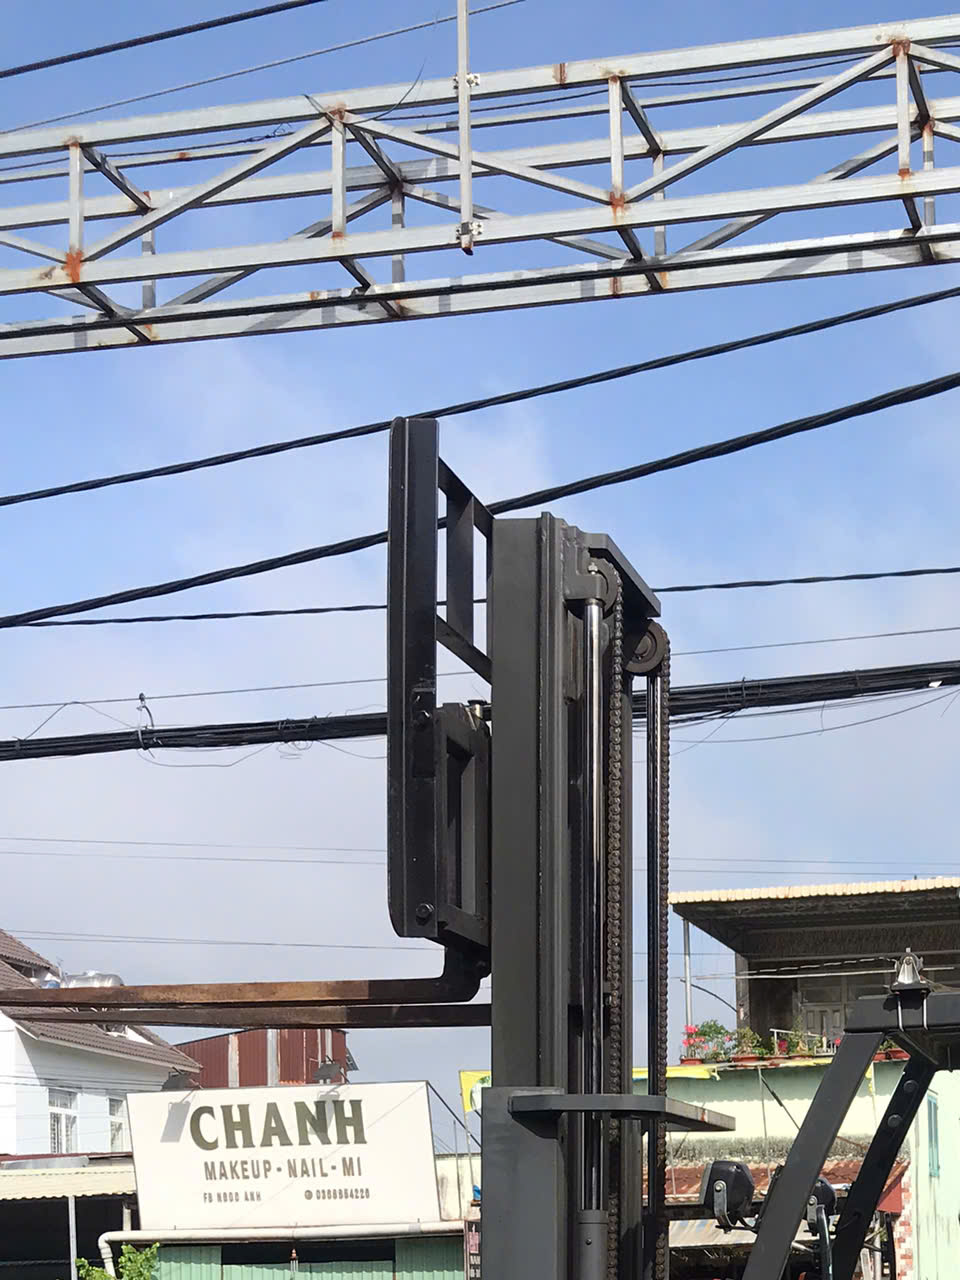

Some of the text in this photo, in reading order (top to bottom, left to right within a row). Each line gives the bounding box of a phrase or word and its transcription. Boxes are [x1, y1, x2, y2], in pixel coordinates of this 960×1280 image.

[189, 1099, 368, 1151] CHANH
[204, 1158, 273, 1181] MAKEUP
[287, 1156, 329, 1179] NAIL
[342, 1156, 362, 1177] MI
